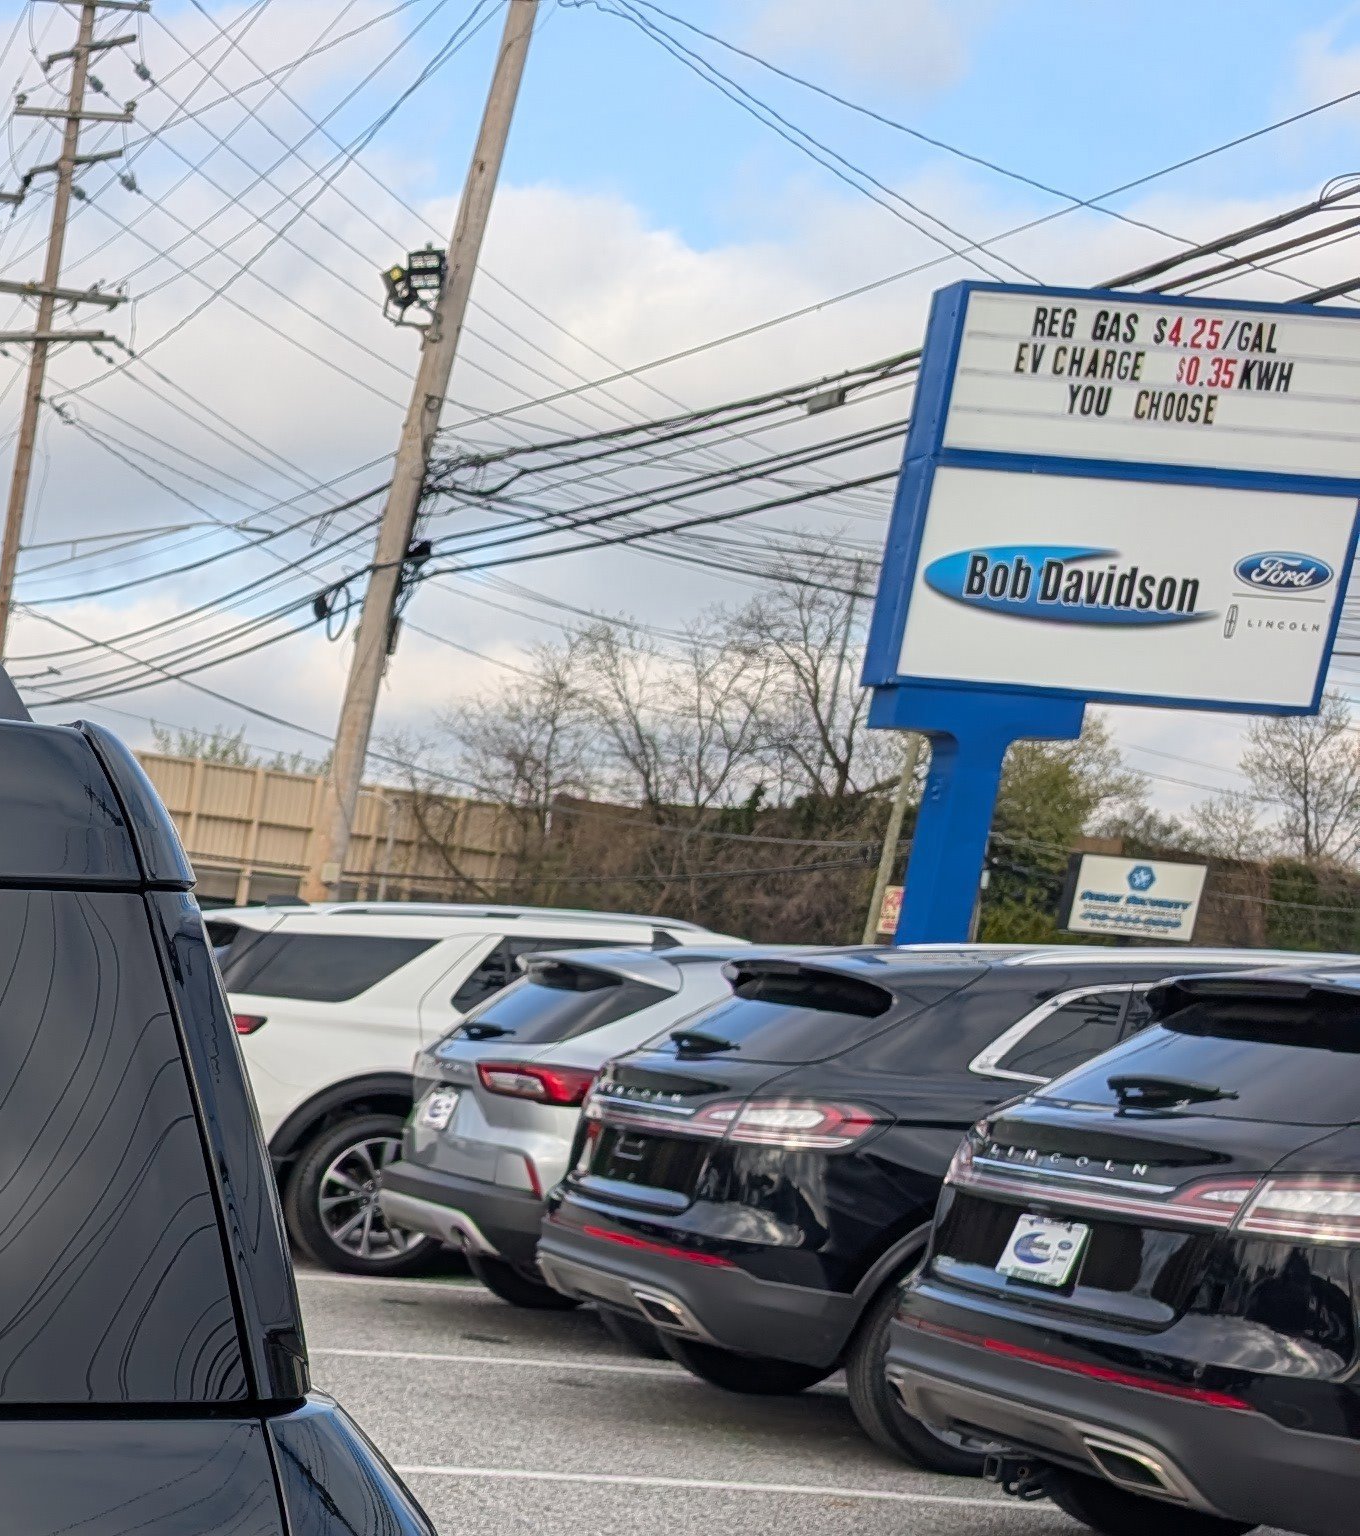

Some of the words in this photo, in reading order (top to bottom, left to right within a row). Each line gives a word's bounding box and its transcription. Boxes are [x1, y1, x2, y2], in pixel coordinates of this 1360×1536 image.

[1031, 307, 1077, 339] REG
[1091, 310, 1139, 344] GAS
[1014, 343, 1045, 374] EV
[1052, 346, 1145, 382] CHARGE
[1067, 384, 1112, 417] YOU
[1134, 390, 1218, 425] CHOOSE
[964, 554, 1031, 601] Bob
[1038, 560, 1200, 614] Davidson
[1250, 558, 1316, 588] Ford
[1247, 619, 1321, 632] LINCOLN
[990, 1143, 1148, 1176] LINCOLN
